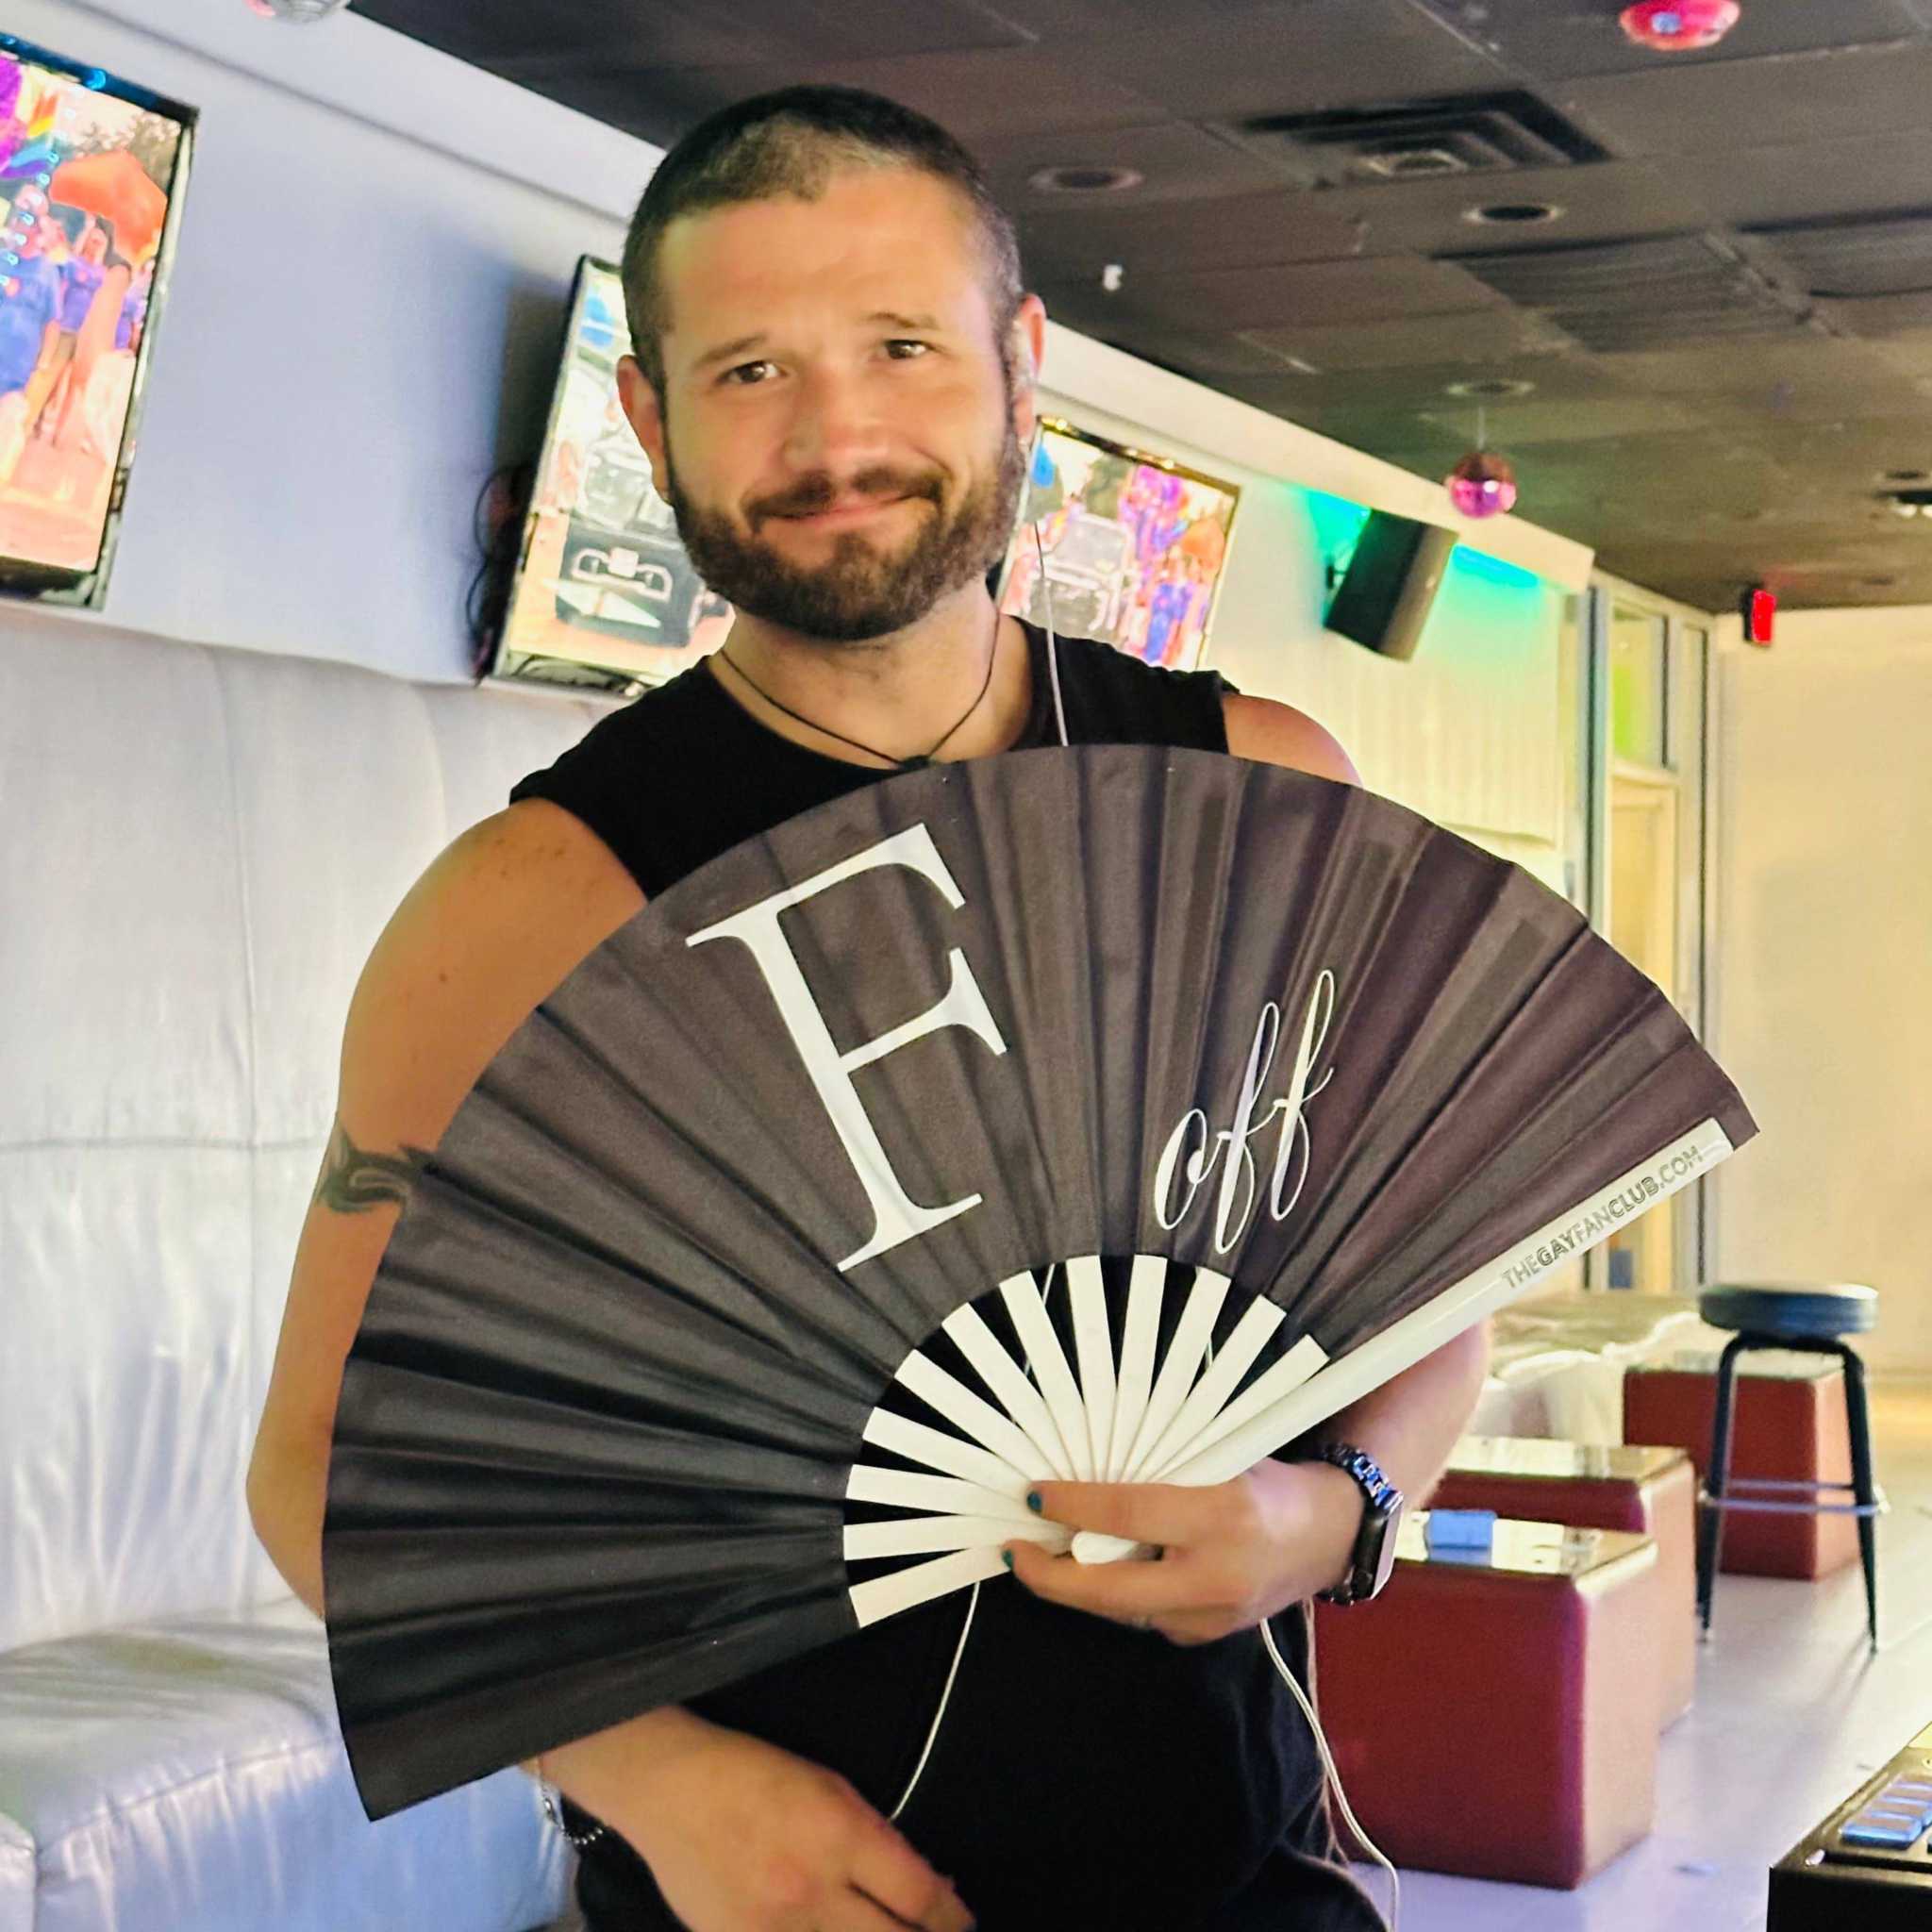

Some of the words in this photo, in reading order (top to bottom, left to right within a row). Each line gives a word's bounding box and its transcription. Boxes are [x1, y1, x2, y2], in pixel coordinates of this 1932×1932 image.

[686, 823, 1007, 1273] F
[1155, 970, 1334, 1255] off
[1502, 1145, 1705, 1289] THEGAYFANCLUB.COM
